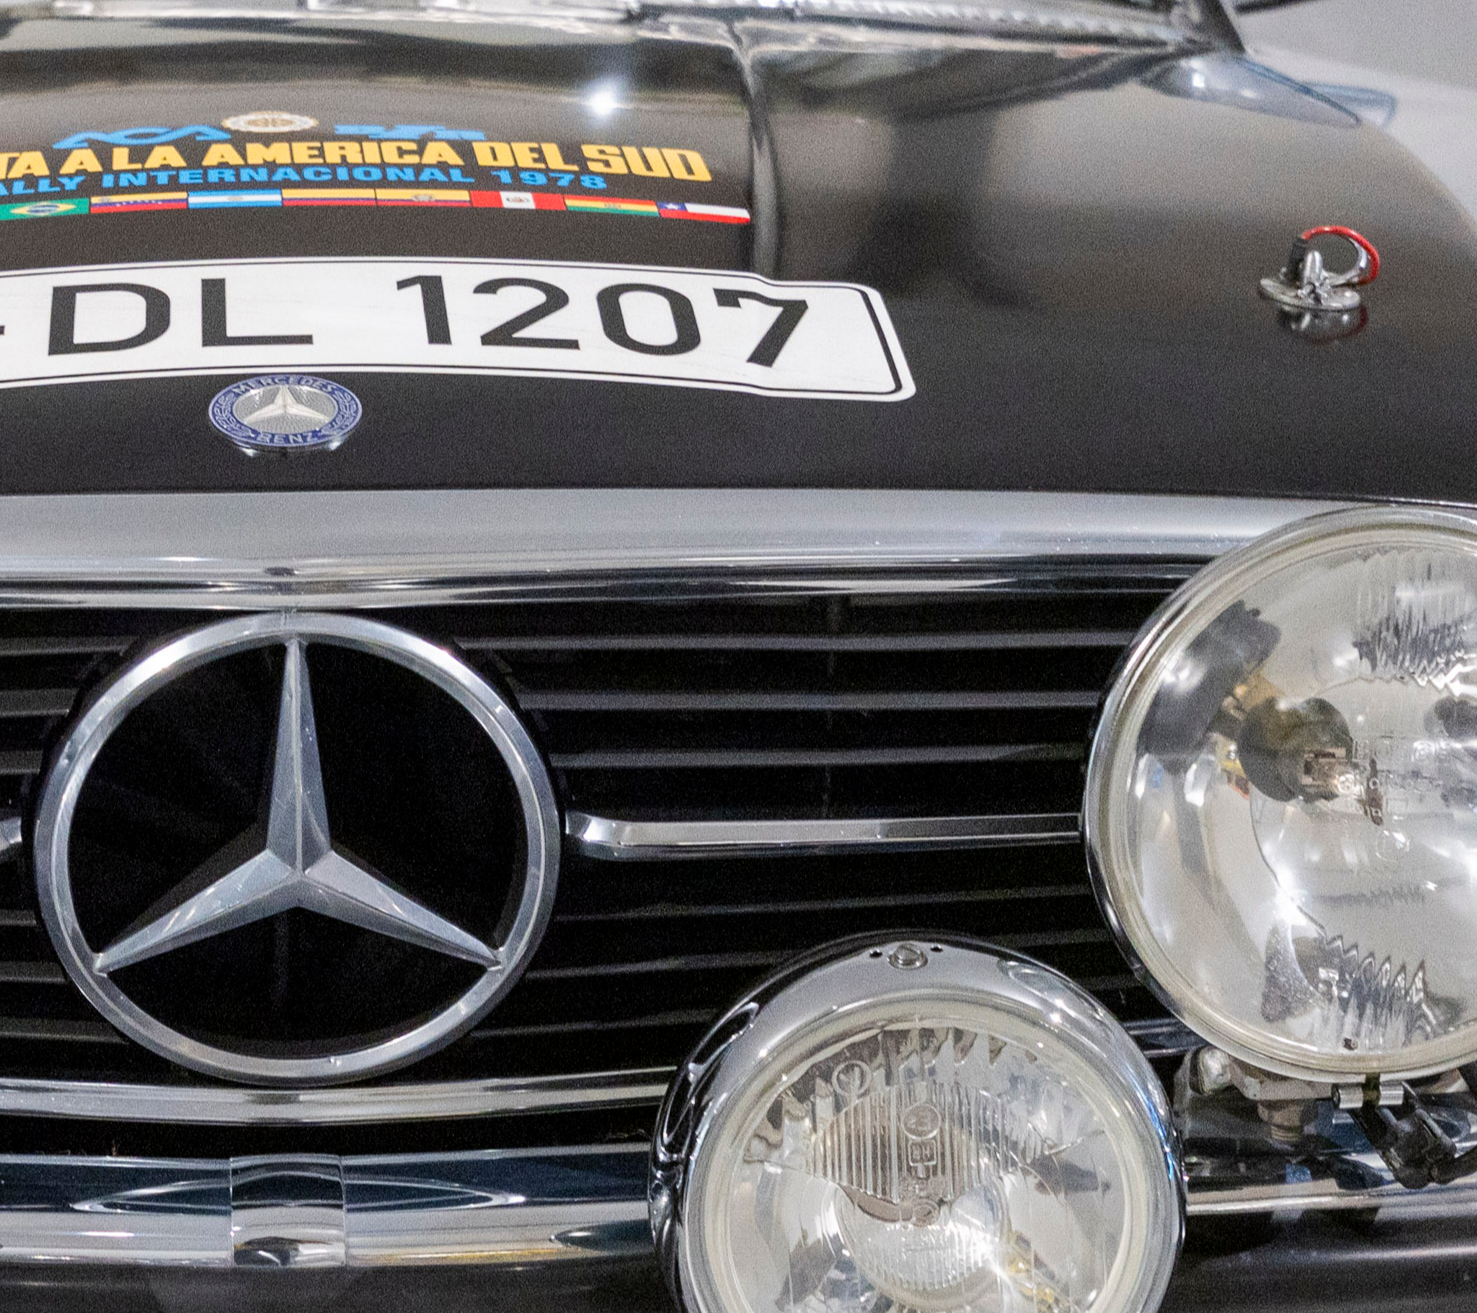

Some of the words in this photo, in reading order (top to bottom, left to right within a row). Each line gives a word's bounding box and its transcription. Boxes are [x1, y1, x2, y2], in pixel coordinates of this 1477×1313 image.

[59, 148, 103, 174] A
[112, 145, 186, 171] LA
[201, 141, 464, 167] AMERICA
[472, 141, 580, 172] DEL
[581, 144, 713, 182] SUD
[101, 165, 476, 188] INTERNACIONAL
[491, 170, 608, 190] 1978
[395, 275, 810, 368] 1207
[231, 376, 338, 395] MERCEDES
[258, 432, 316, 444] BENZ
